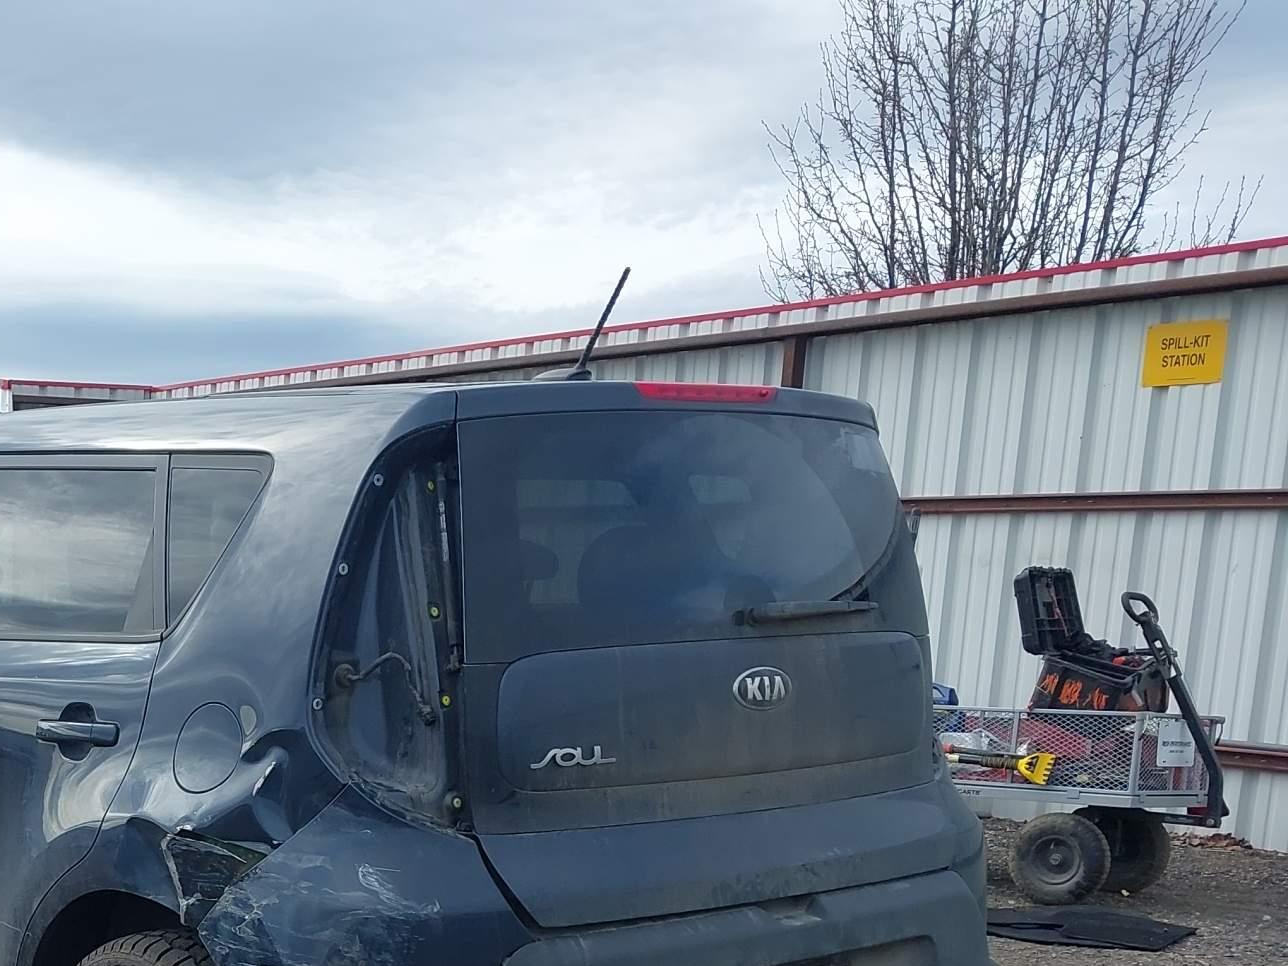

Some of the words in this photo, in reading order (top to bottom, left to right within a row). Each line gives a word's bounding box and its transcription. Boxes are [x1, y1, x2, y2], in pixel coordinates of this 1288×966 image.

[1161, 335, 1211, 350] SPILL-KIT
[1162, 353, 1206, 368] STATION
[745, 675, 785, 700] KIA
[530, 745, 617, 770] SOUL
